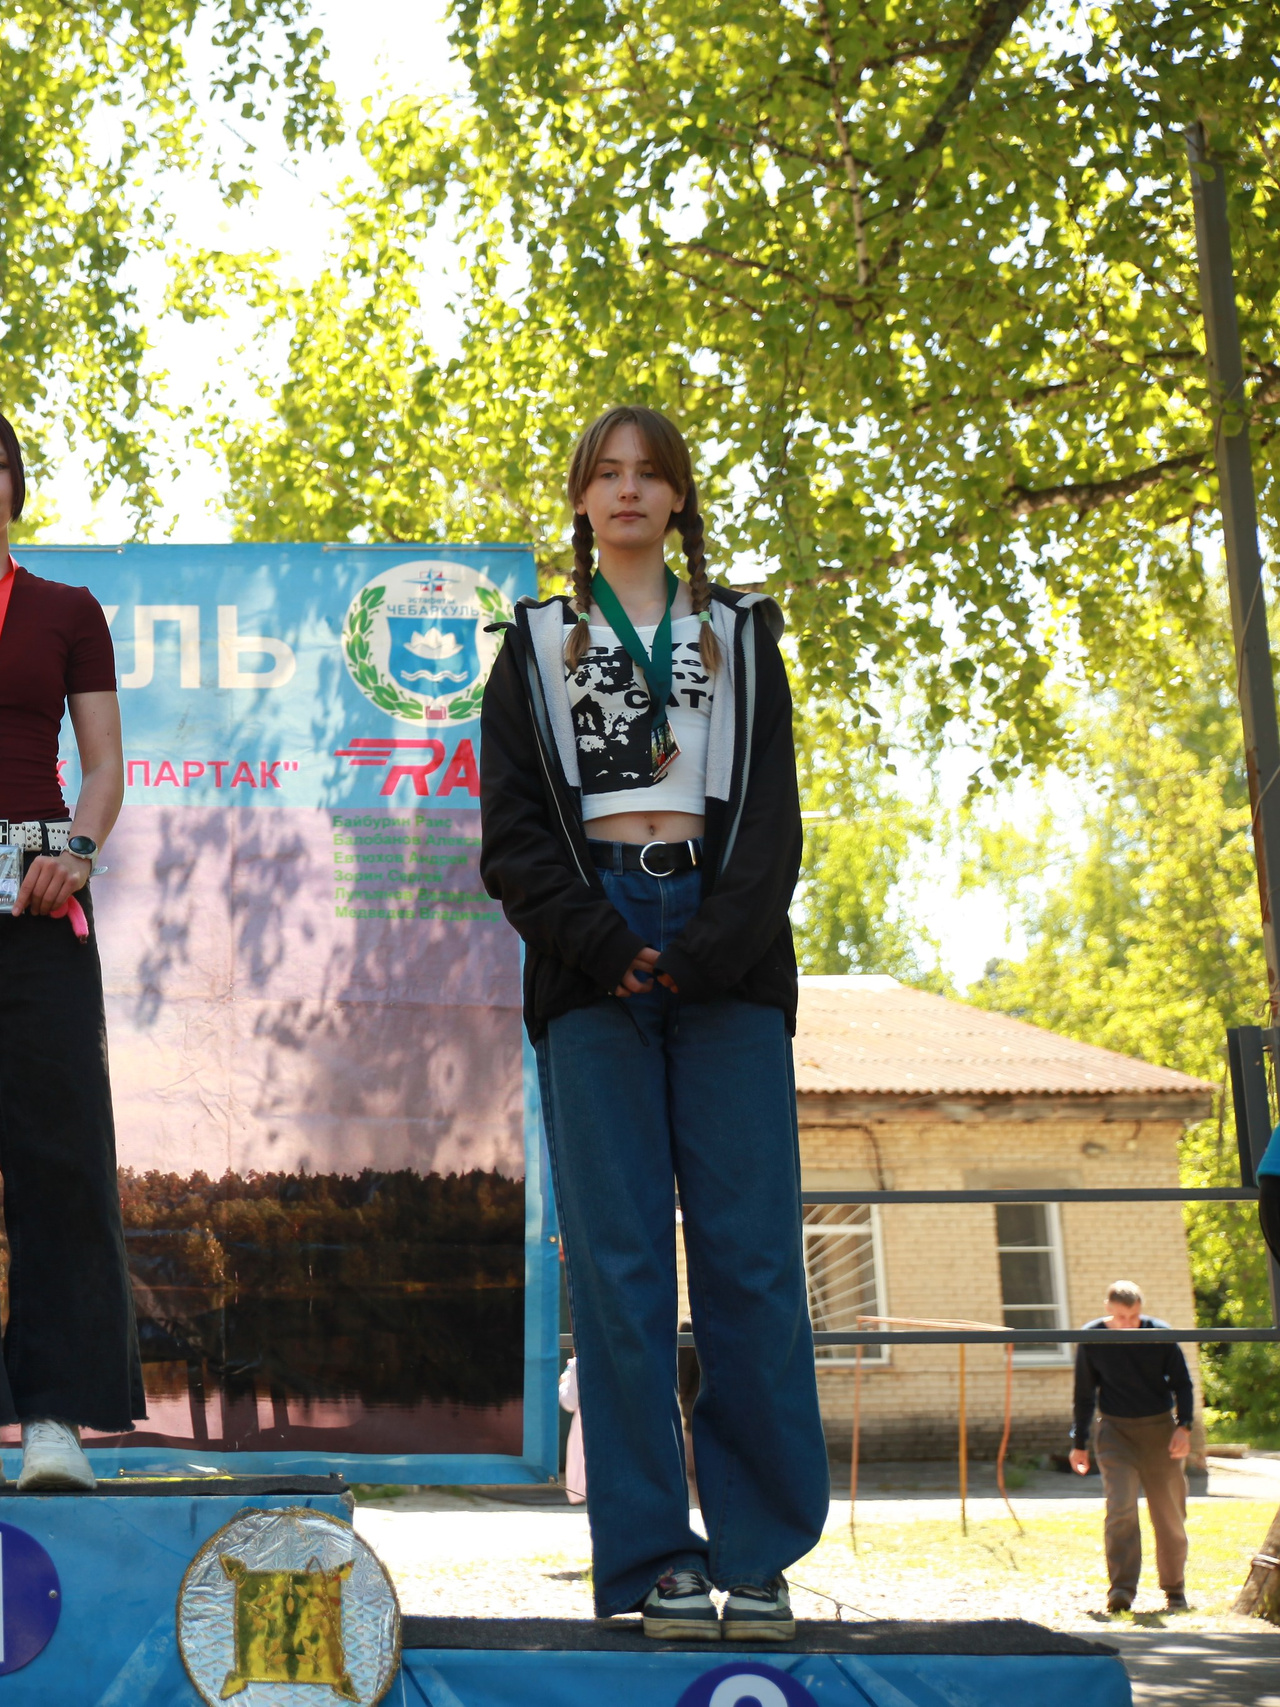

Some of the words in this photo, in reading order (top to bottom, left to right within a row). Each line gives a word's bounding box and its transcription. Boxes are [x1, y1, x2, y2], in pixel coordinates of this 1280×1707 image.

[386, 604, 480, 617] ЧЕБАРКУЛЬ
[127, 760, 299, 788] ПАРТАК"
[334, 738, 481, 797] RA
[333, 815, 411, 830] Байбурин
[416, 815, 453, 829] Раис
[333, 833, 421, 846] Балобанов
[425, 834, 482, 847] Алекса
[334, 852, 404, 864] Евтюхов
[408, 851, 468, 866] Андрей
[334, 870, 384, 883] Зорин
[387, 869, 444, 884] Сергей
[335, 906, 416, 920] Медведев
[420, 907, 502, 923] Владимир
